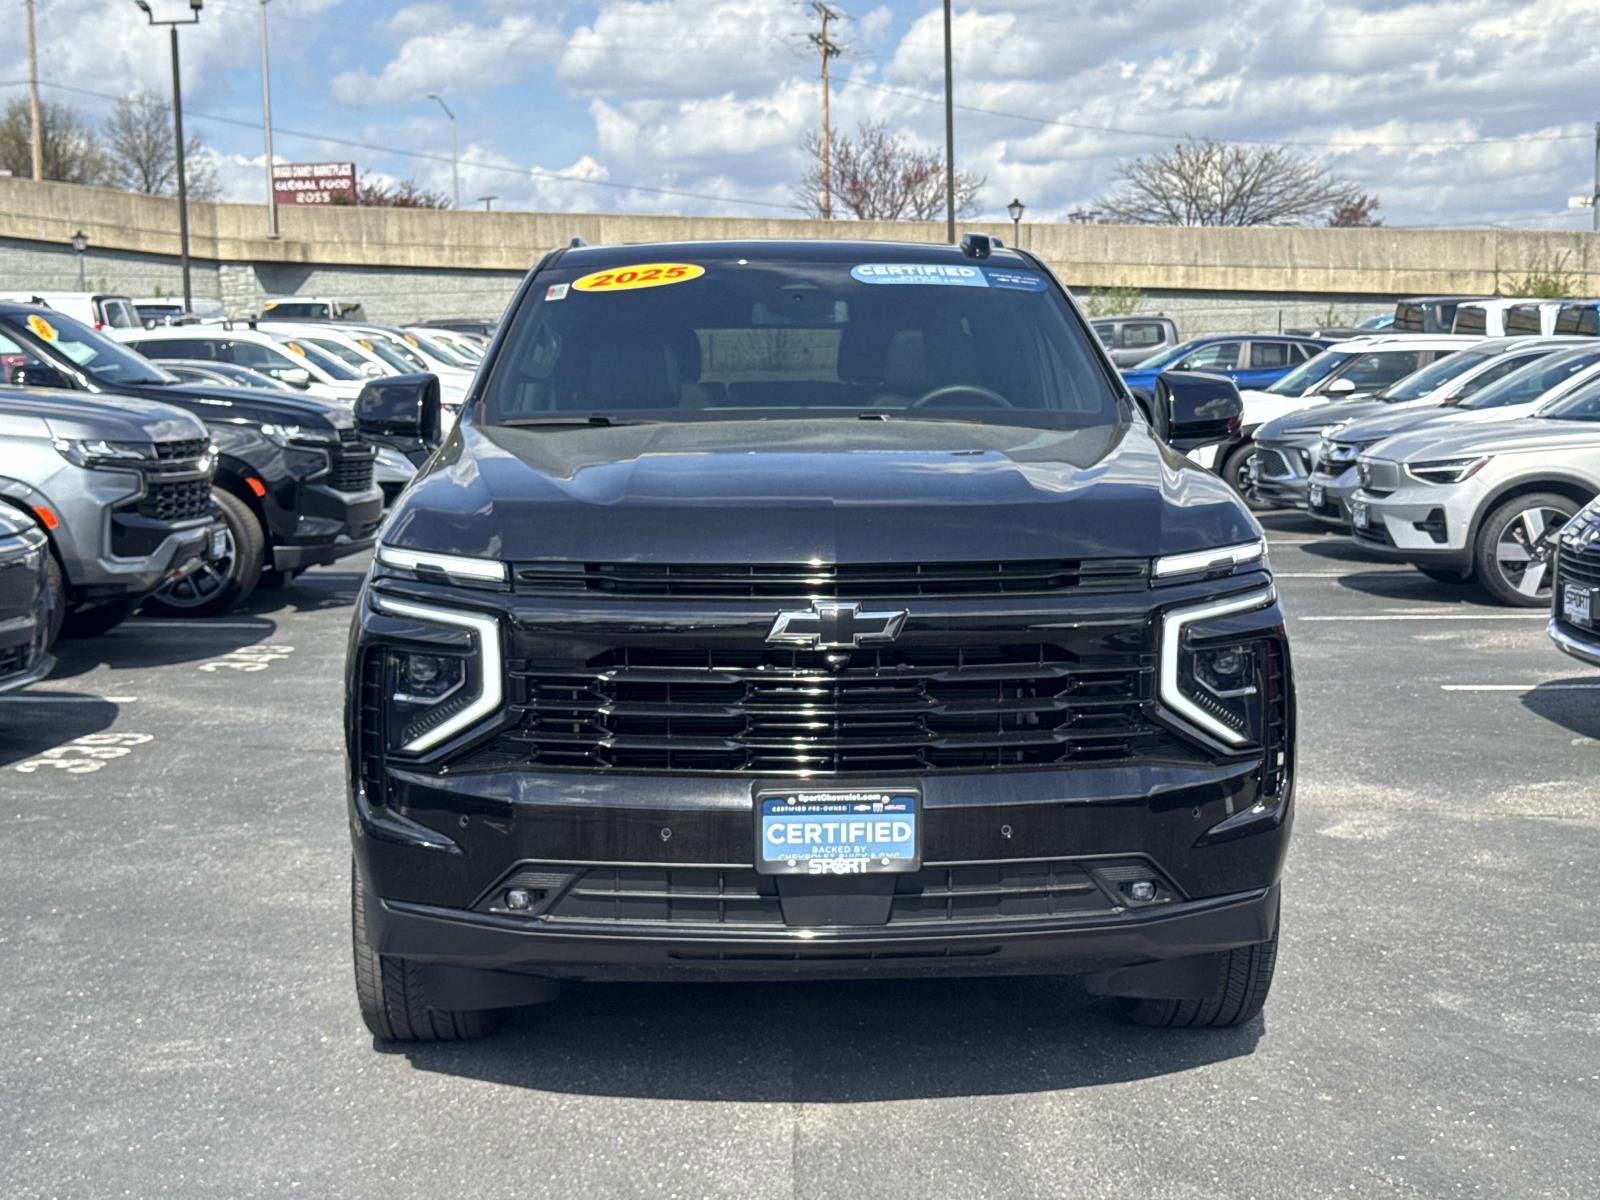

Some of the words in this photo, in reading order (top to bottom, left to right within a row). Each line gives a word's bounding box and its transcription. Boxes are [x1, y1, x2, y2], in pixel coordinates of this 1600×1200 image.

[275, 180, 318, 191] GLOBAL
[320, 179, 351, 189] FOOD
[296, 191, 331, 203] ROSS
[589, 266, 689, 288] 2025
[857, 266, 977, 278] CERTIFIED
[798, 794, 881, 803] SportChevrolet.com
[772, 805, 807, 813] CERTIFIED
[767, 822, 912, 845] CERTIFIED
[812, 845, 850, 854] BACKED
[853, 845, 867, 853] BY
[808, 857, 871, 875] SPORT
